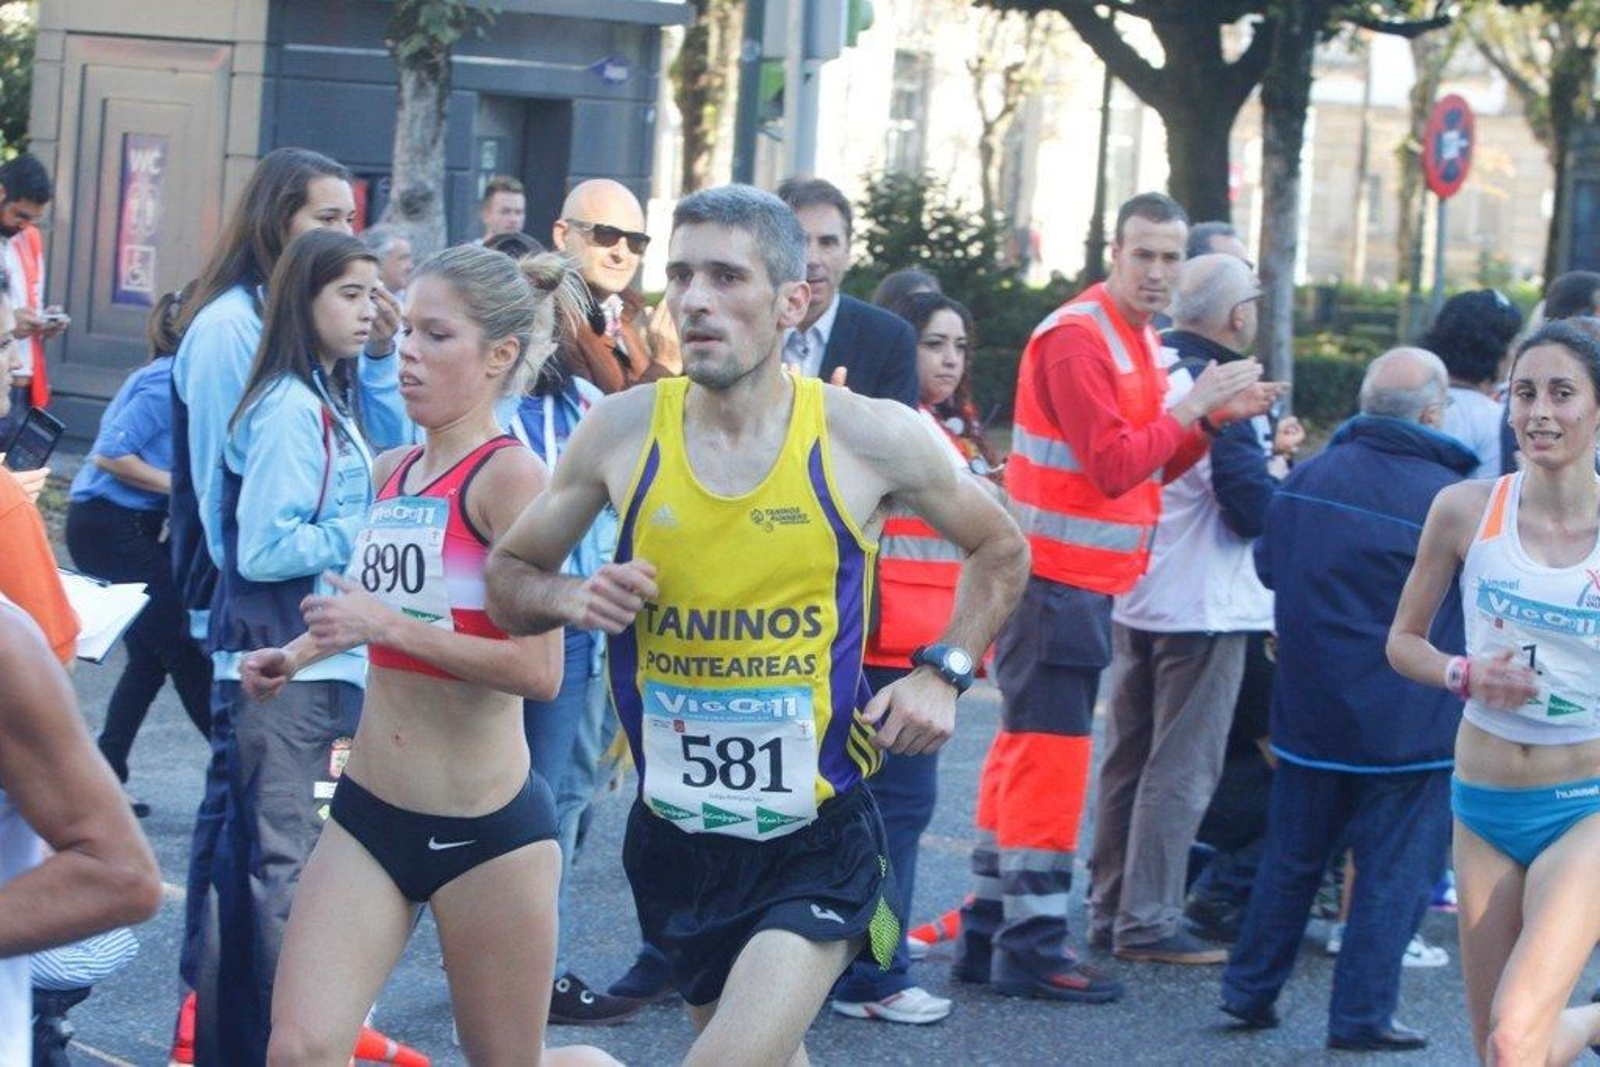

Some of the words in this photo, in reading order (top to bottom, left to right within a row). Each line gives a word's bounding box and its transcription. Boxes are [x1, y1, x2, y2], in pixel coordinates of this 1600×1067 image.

[129, 148, 161, 175] WC
[361, 542, 425, 594] 890
[643, 602, 823, 642] TANINOS
[646, 650, 817, 678] PONTEAREAS
[680, 734, 793, 793] 581
